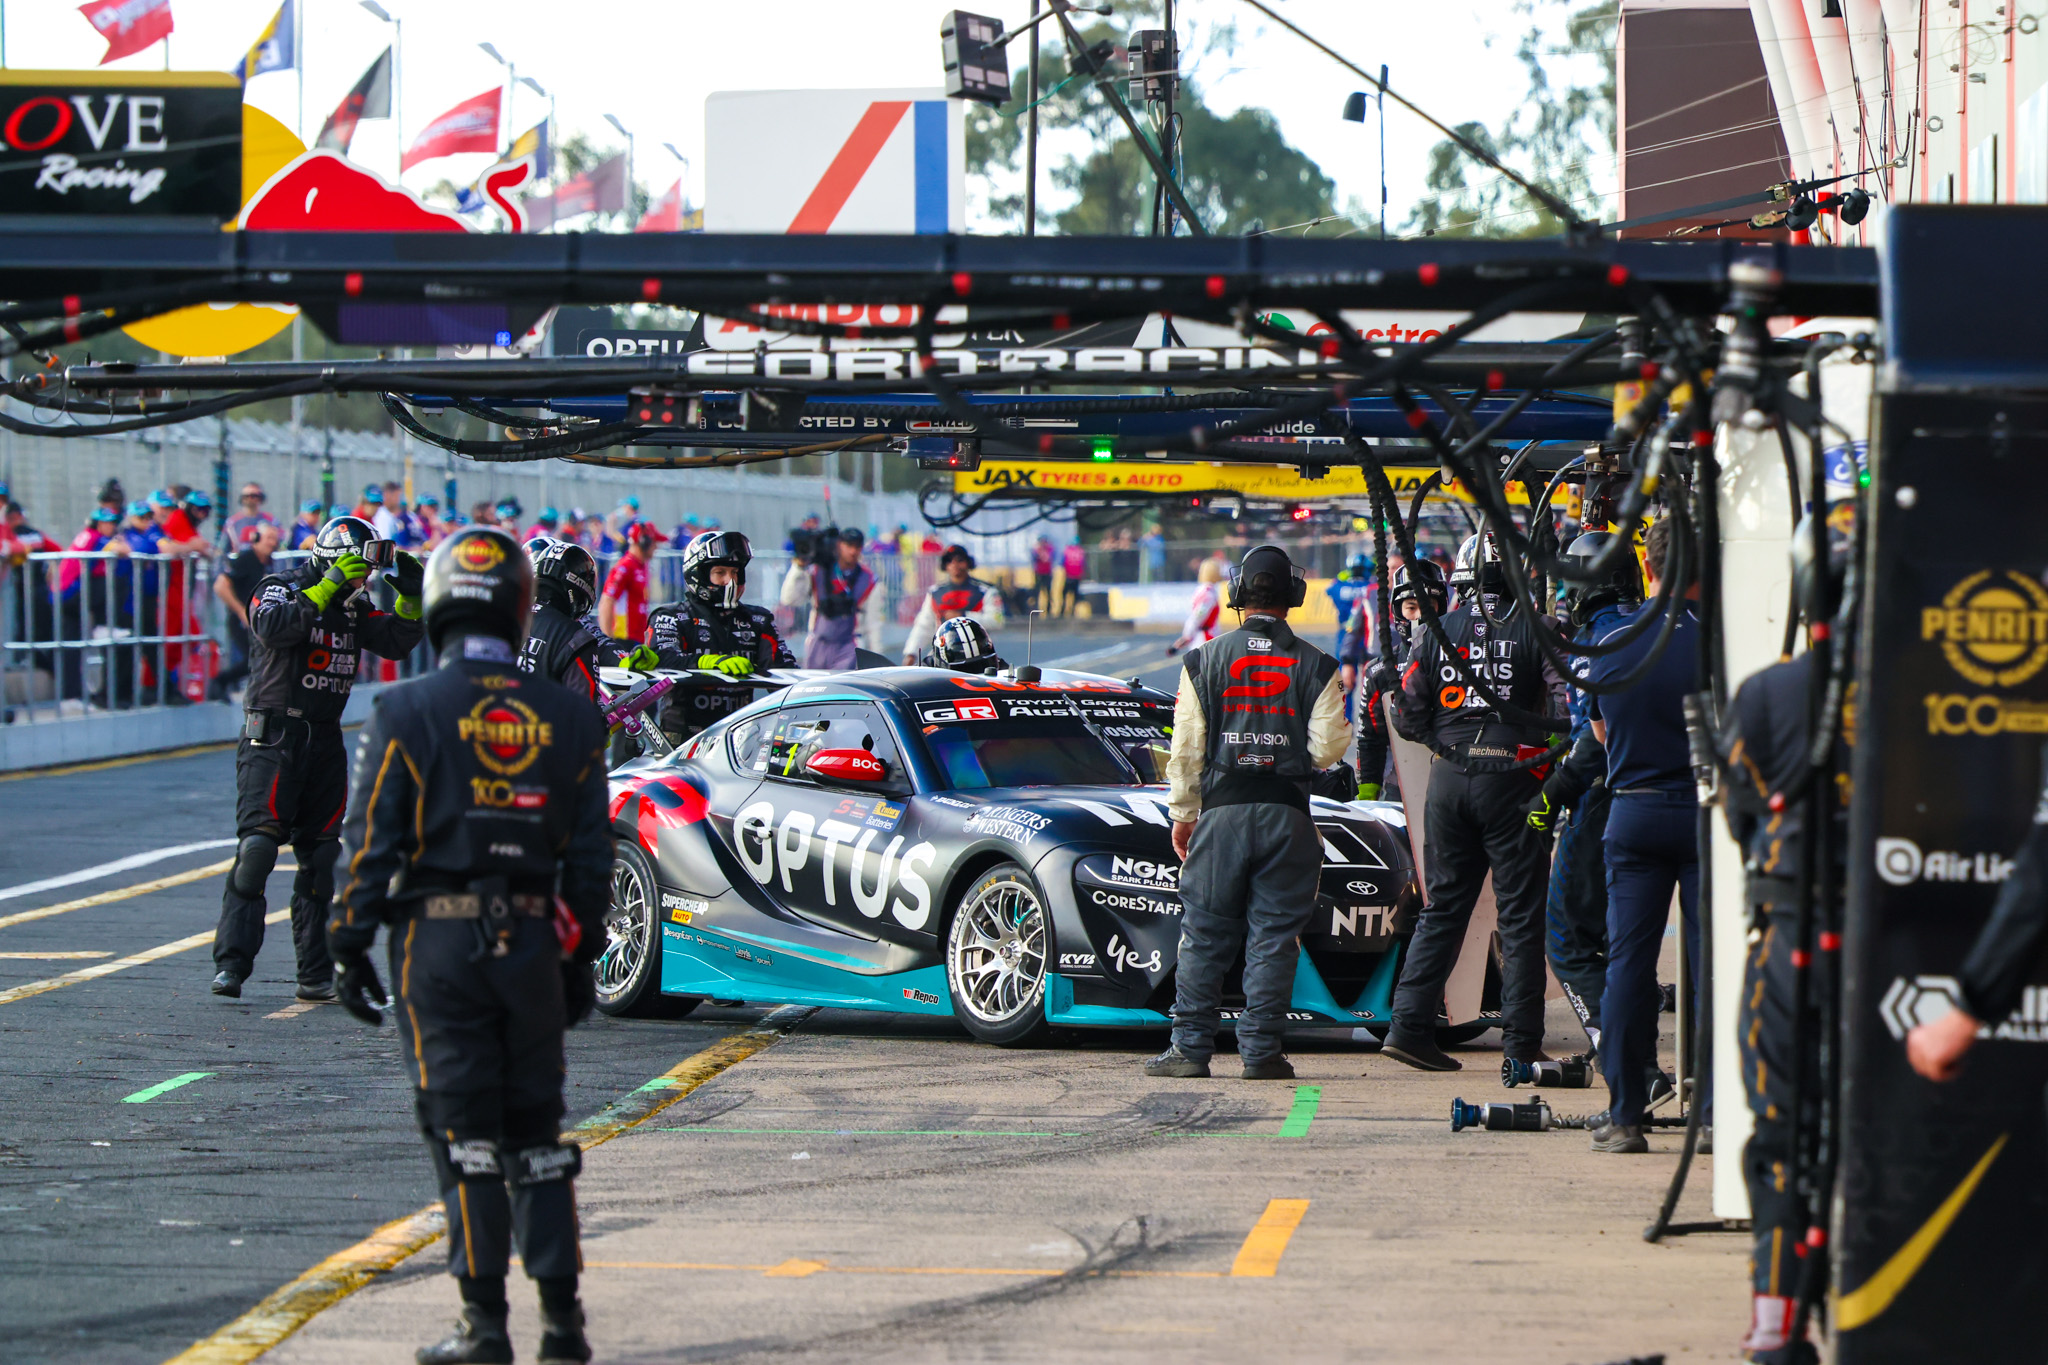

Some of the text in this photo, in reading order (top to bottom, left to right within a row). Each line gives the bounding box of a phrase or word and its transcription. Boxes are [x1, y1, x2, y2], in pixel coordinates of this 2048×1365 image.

[0, 94, 167, 151] OVE
[34, 153, 167, 204] Racing
[863, 418, 891, 428] BY
[974, 468, 1037, 486] JAX
[1041, 473, 1106, 485] TYRES
[1127, 474, 1183, 486] AUTO
[1248, 640, 1272, 649] OMP
[1441, 663, 1513, 682] OTUS
[924, 706, 994, 721] GR
[1009, 707, 1141, 718] Australia
[1101, 725, 1166, 738] ostert
[1222, 733, 1290, 746] TELEVISION
[782, 743, 799, 776] 1
[852, 758, 881, 772] BOC
[865, 815, 894, 830] Batteries
[976, 818, 1038, 846] WESTERN
[733, 801, 937, 931] OPTUS
[1111, 855, 1179, 883] NGK
[1923, 851, 1972, 882] Air
[1111, 874, 1176, 889] SPARK PLUGS
[661, 893, 710, 916] SUPERCHEAP
[673, 912, 690, 922] AUTO
[1331, 905, 1398, 936] NTK
[1059, 953, 1096, 965] KYB
[913, 989, 940, 1004] Repco
